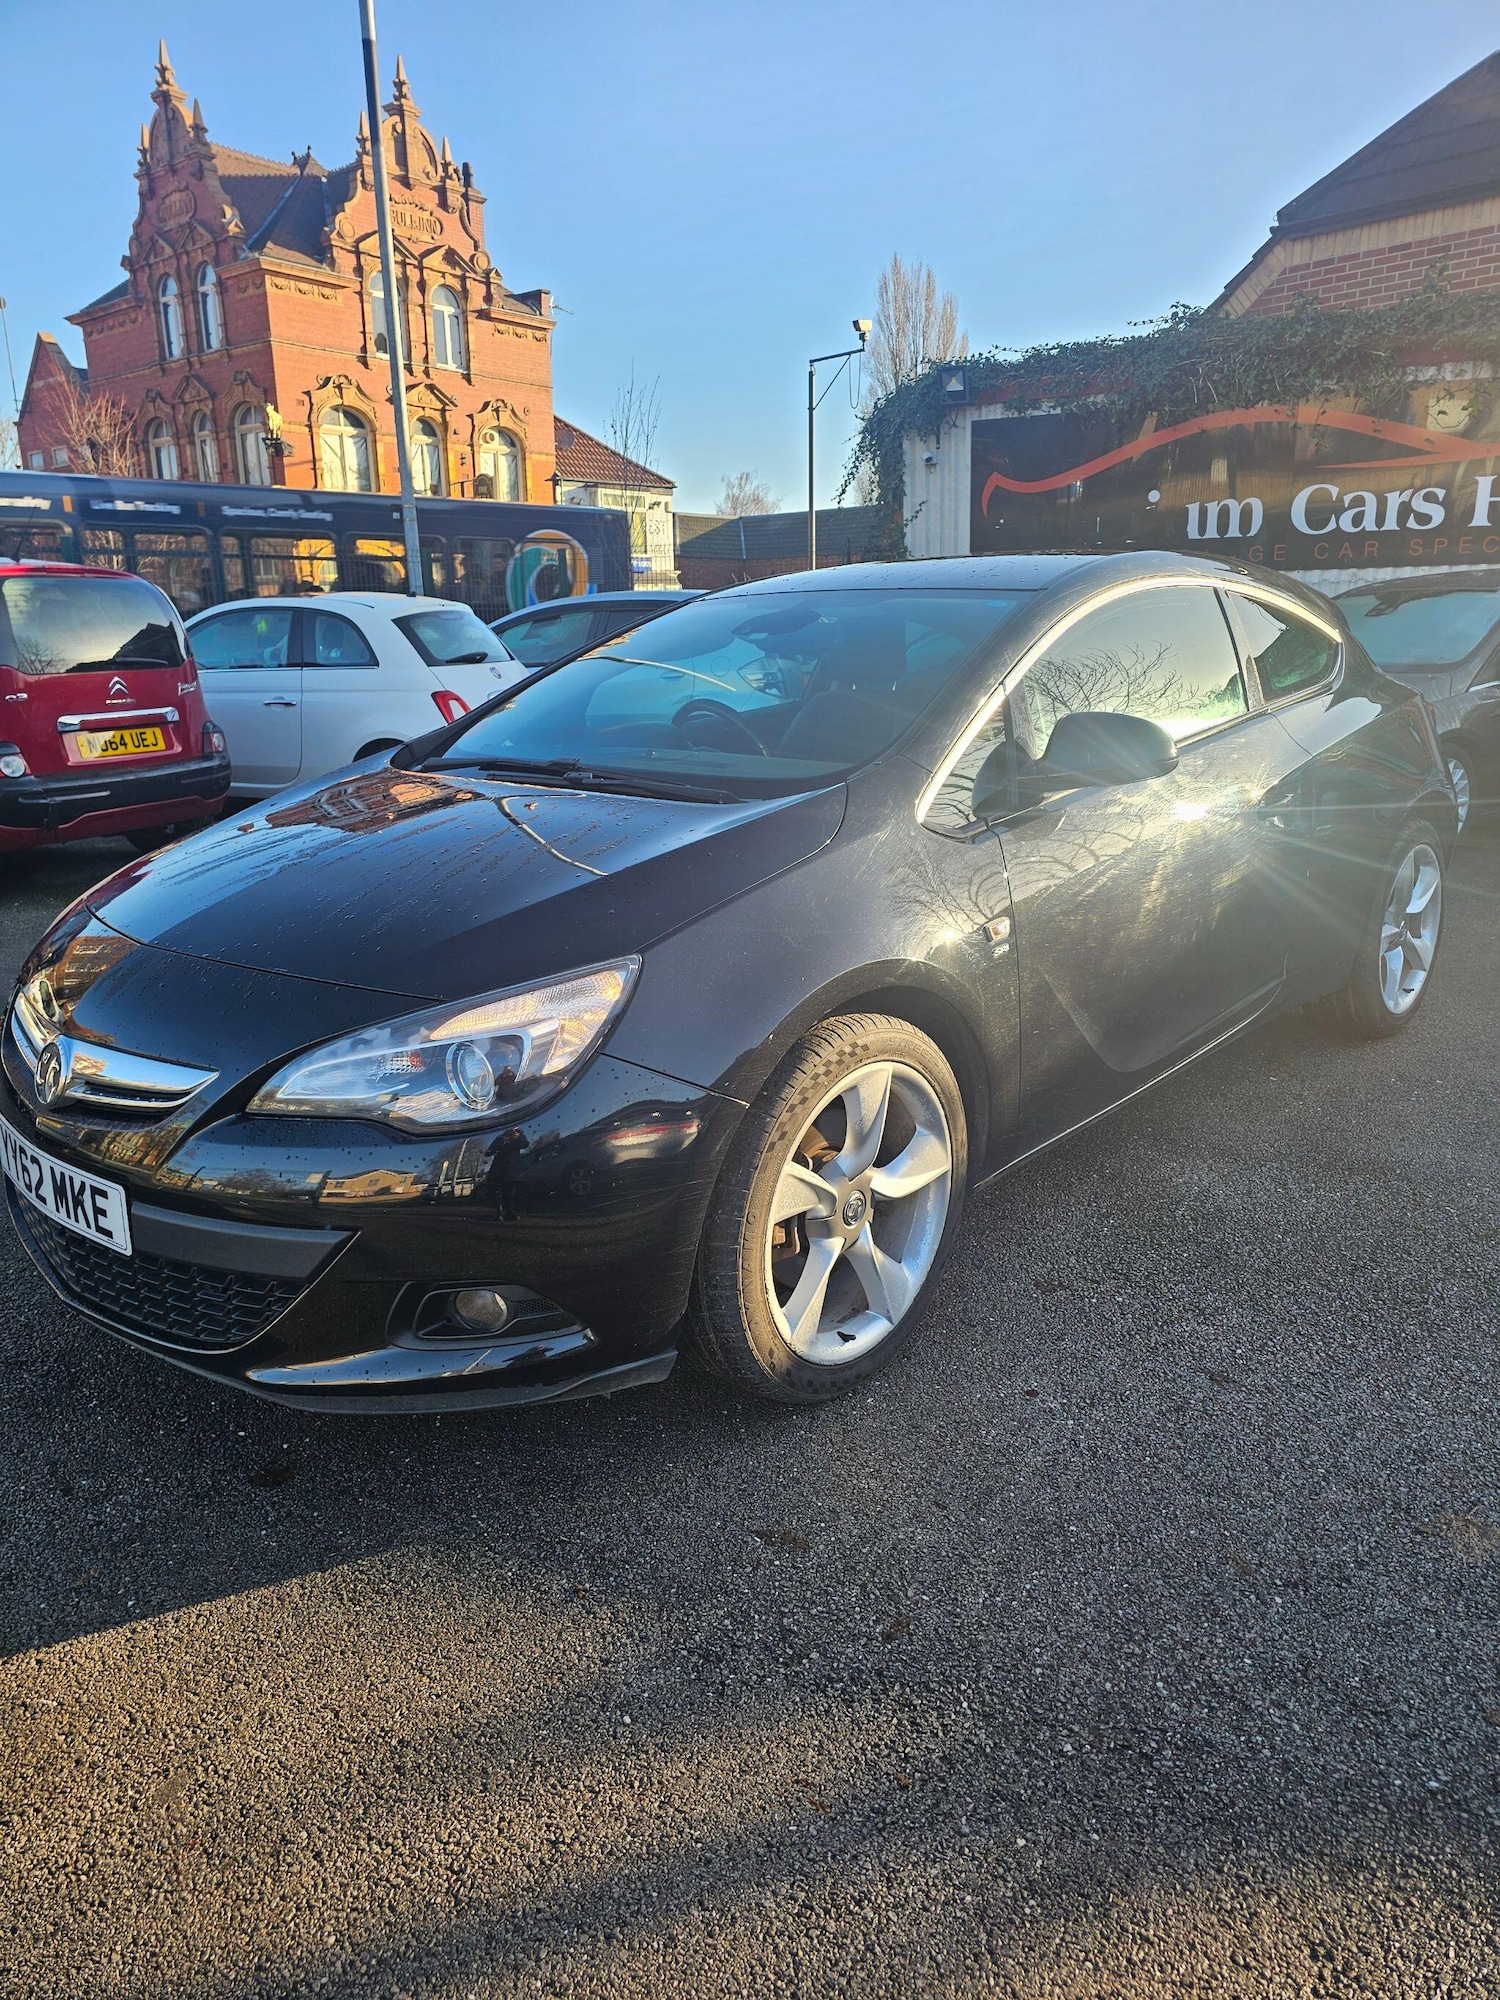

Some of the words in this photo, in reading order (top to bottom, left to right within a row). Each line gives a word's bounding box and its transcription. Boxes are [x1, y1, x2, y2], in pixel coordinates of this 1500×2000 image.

[1290, 483, 1447, 535] Cars
[1313, 540, 1380, 560] CAR
[131, 730, 159, 748] UEJ
[0, 1123, 48, 1207] YY62
[49, 1164, 114, 1240] MKE
